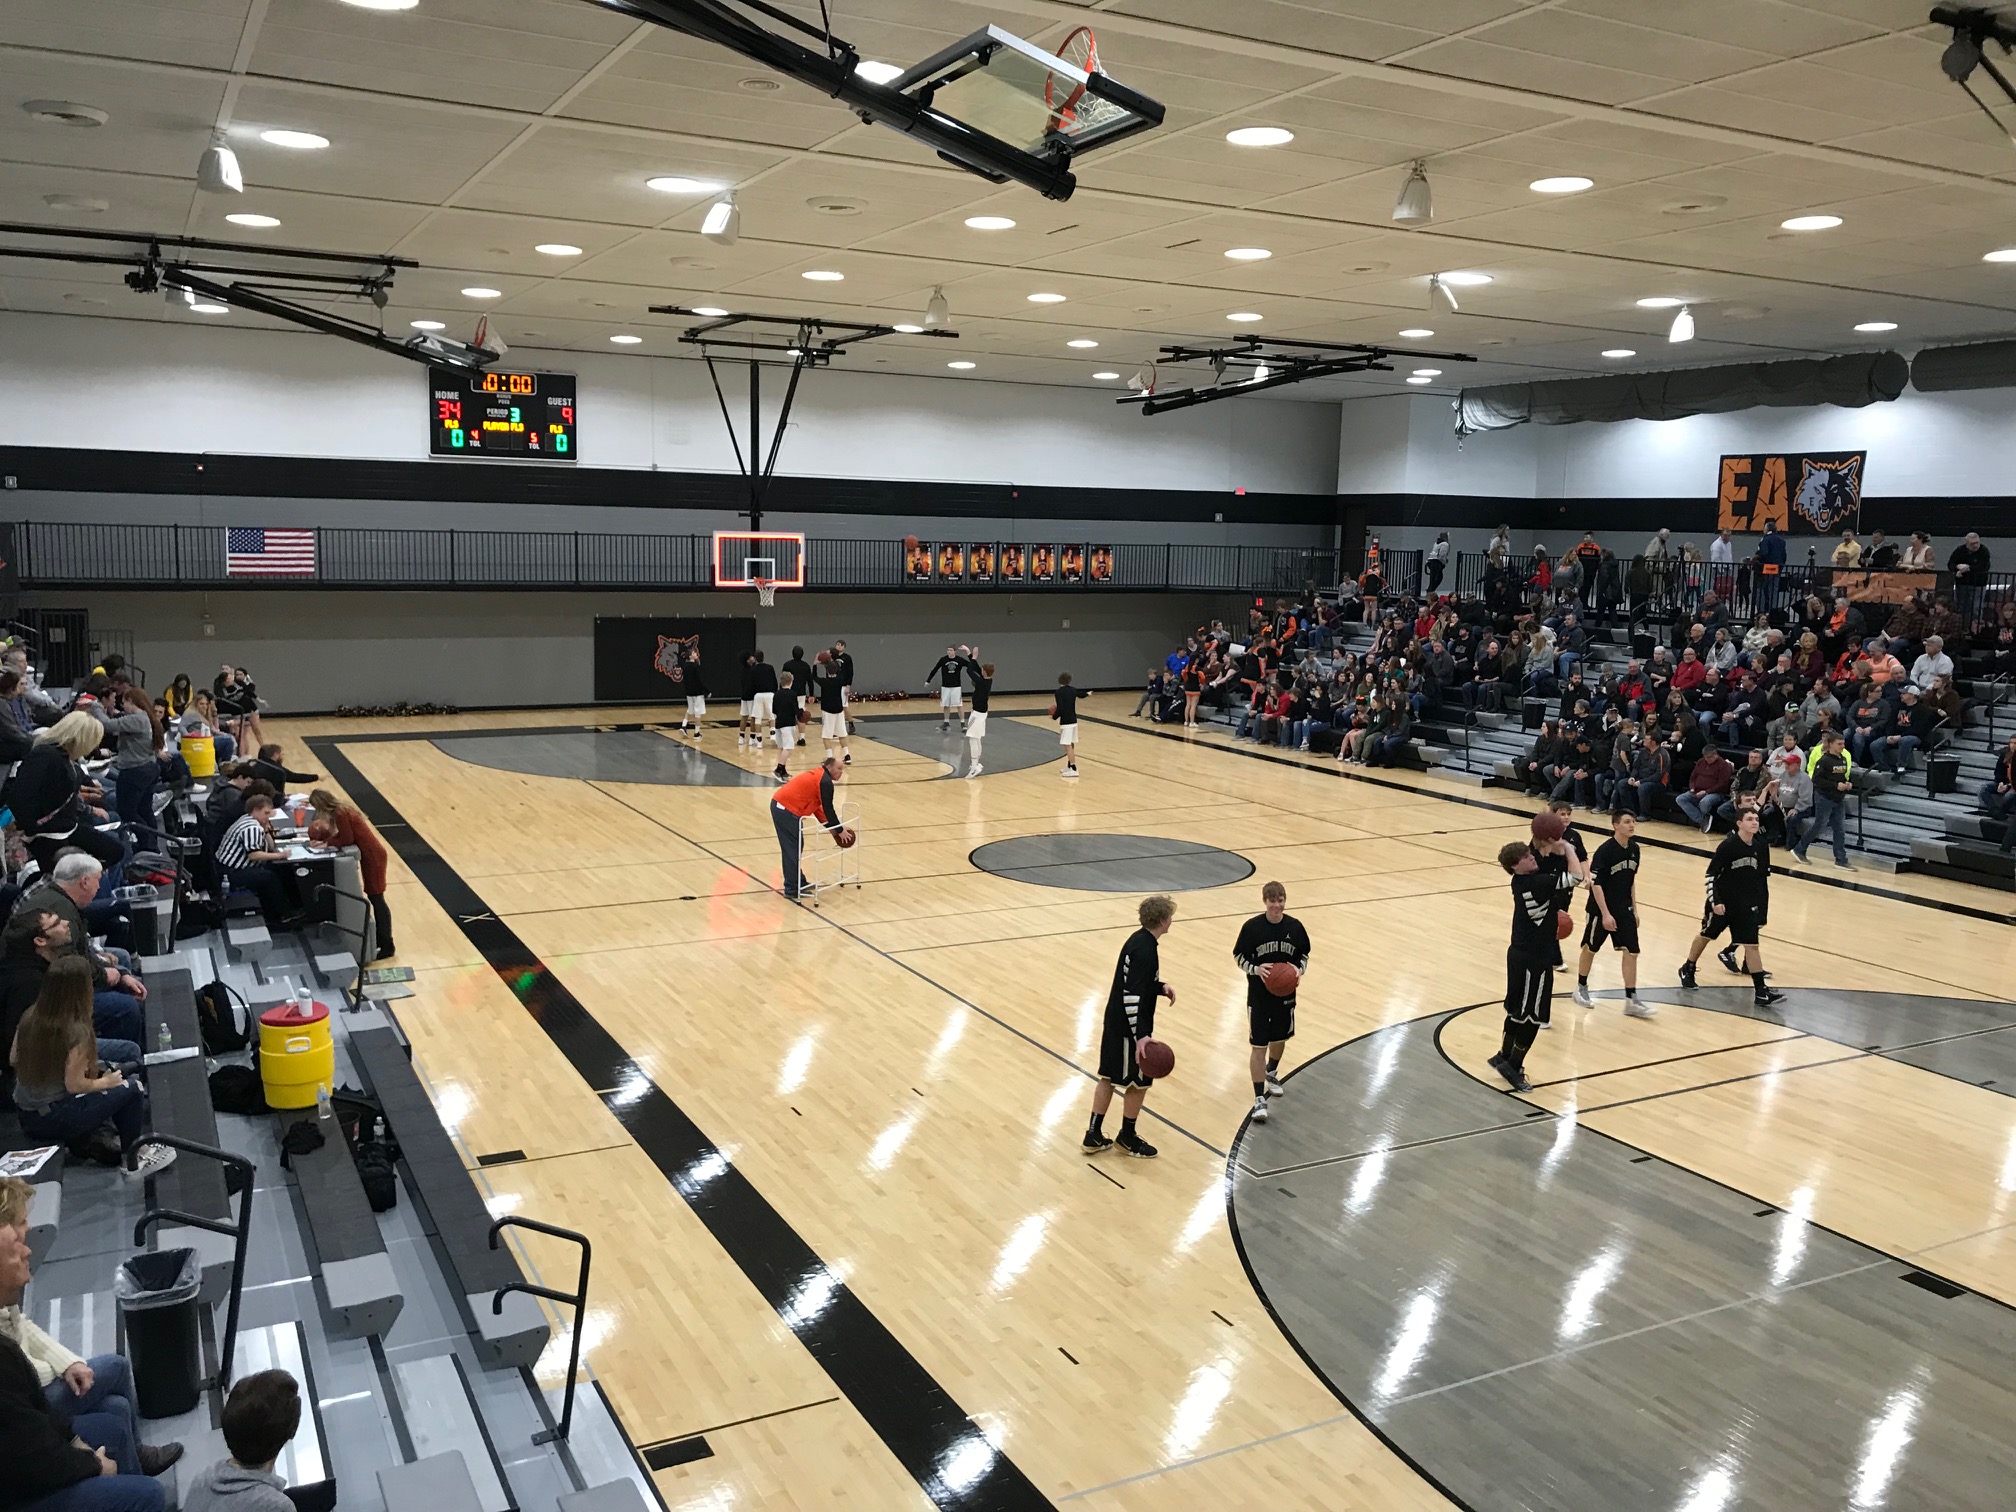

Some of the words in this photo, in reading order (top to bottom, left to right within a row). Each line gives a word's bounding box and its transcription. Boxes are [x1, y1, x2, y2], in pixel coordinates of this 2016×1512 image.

[434, 391, 460, 400] HOME
[547, 397, 572, 406] GUEST
[438, 400, 461, 419] 34
[486, 408, 508, 416] PERIOD
[510, 407, 520, 423] 3
[561, 407, 573, 425] 9
[451, 428, 464, 448] 0
[470, 429, 479, 440] 4
[556, 434, 568, 452] 0
[1718, 458, 1789, 531] EA
[1256, 941, 1279, 957] SOUTH
